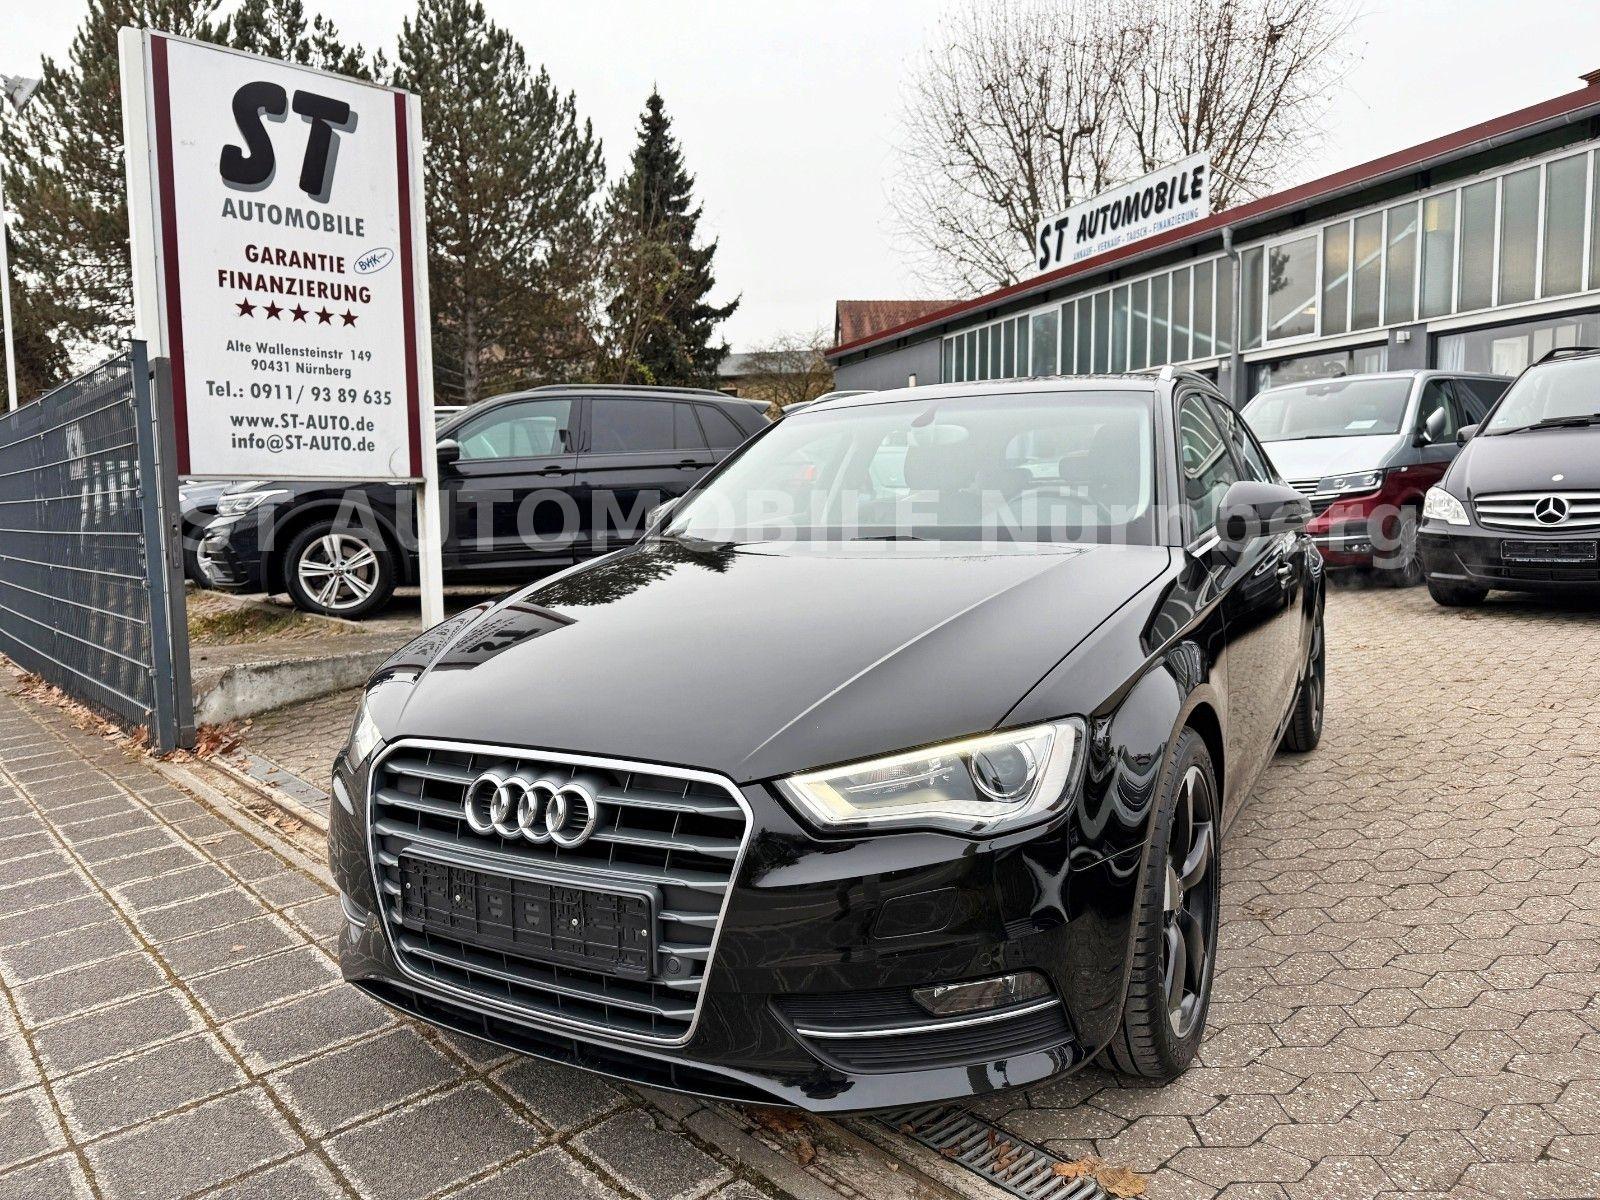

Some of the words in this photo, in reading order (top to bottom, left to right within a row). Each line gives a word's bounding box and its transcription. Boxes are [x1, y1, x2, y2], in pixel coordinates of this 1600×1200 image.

[219, 81, 358, 204] ST
[221, 197, 365, 238] AUTOMOBILE
[1039, 216, 1069, 271] ST
[1076, 164, 1205, 244] AUTOMOBILE
[1126, 226, 1148, 242] TAUSCH
[1152, 207, 1199, 233] FINANZIERUNG
[245, 244, 346, 274] GARANTIE
[217, 269, 372, 304] FINANZIERUNG
[226, 339, 251, 353] Alte
[256, 341, 343, 360] Wallensteinstr
[350, 349, 372, 362] 149
[251, 359, 290, 373] 90431
[296, 362, 352, 379] Nürnberg
[206, 380, 244, 398] Tel.:
[311, 386, 332, 403] 93
[338, 388, 357, 404] 89
[363, 389, 392, 406] 635
[230, 413, 375, 432] www.ST-AUTO.de
[231, 433, 376, 453] info@ST-AUTO.de
